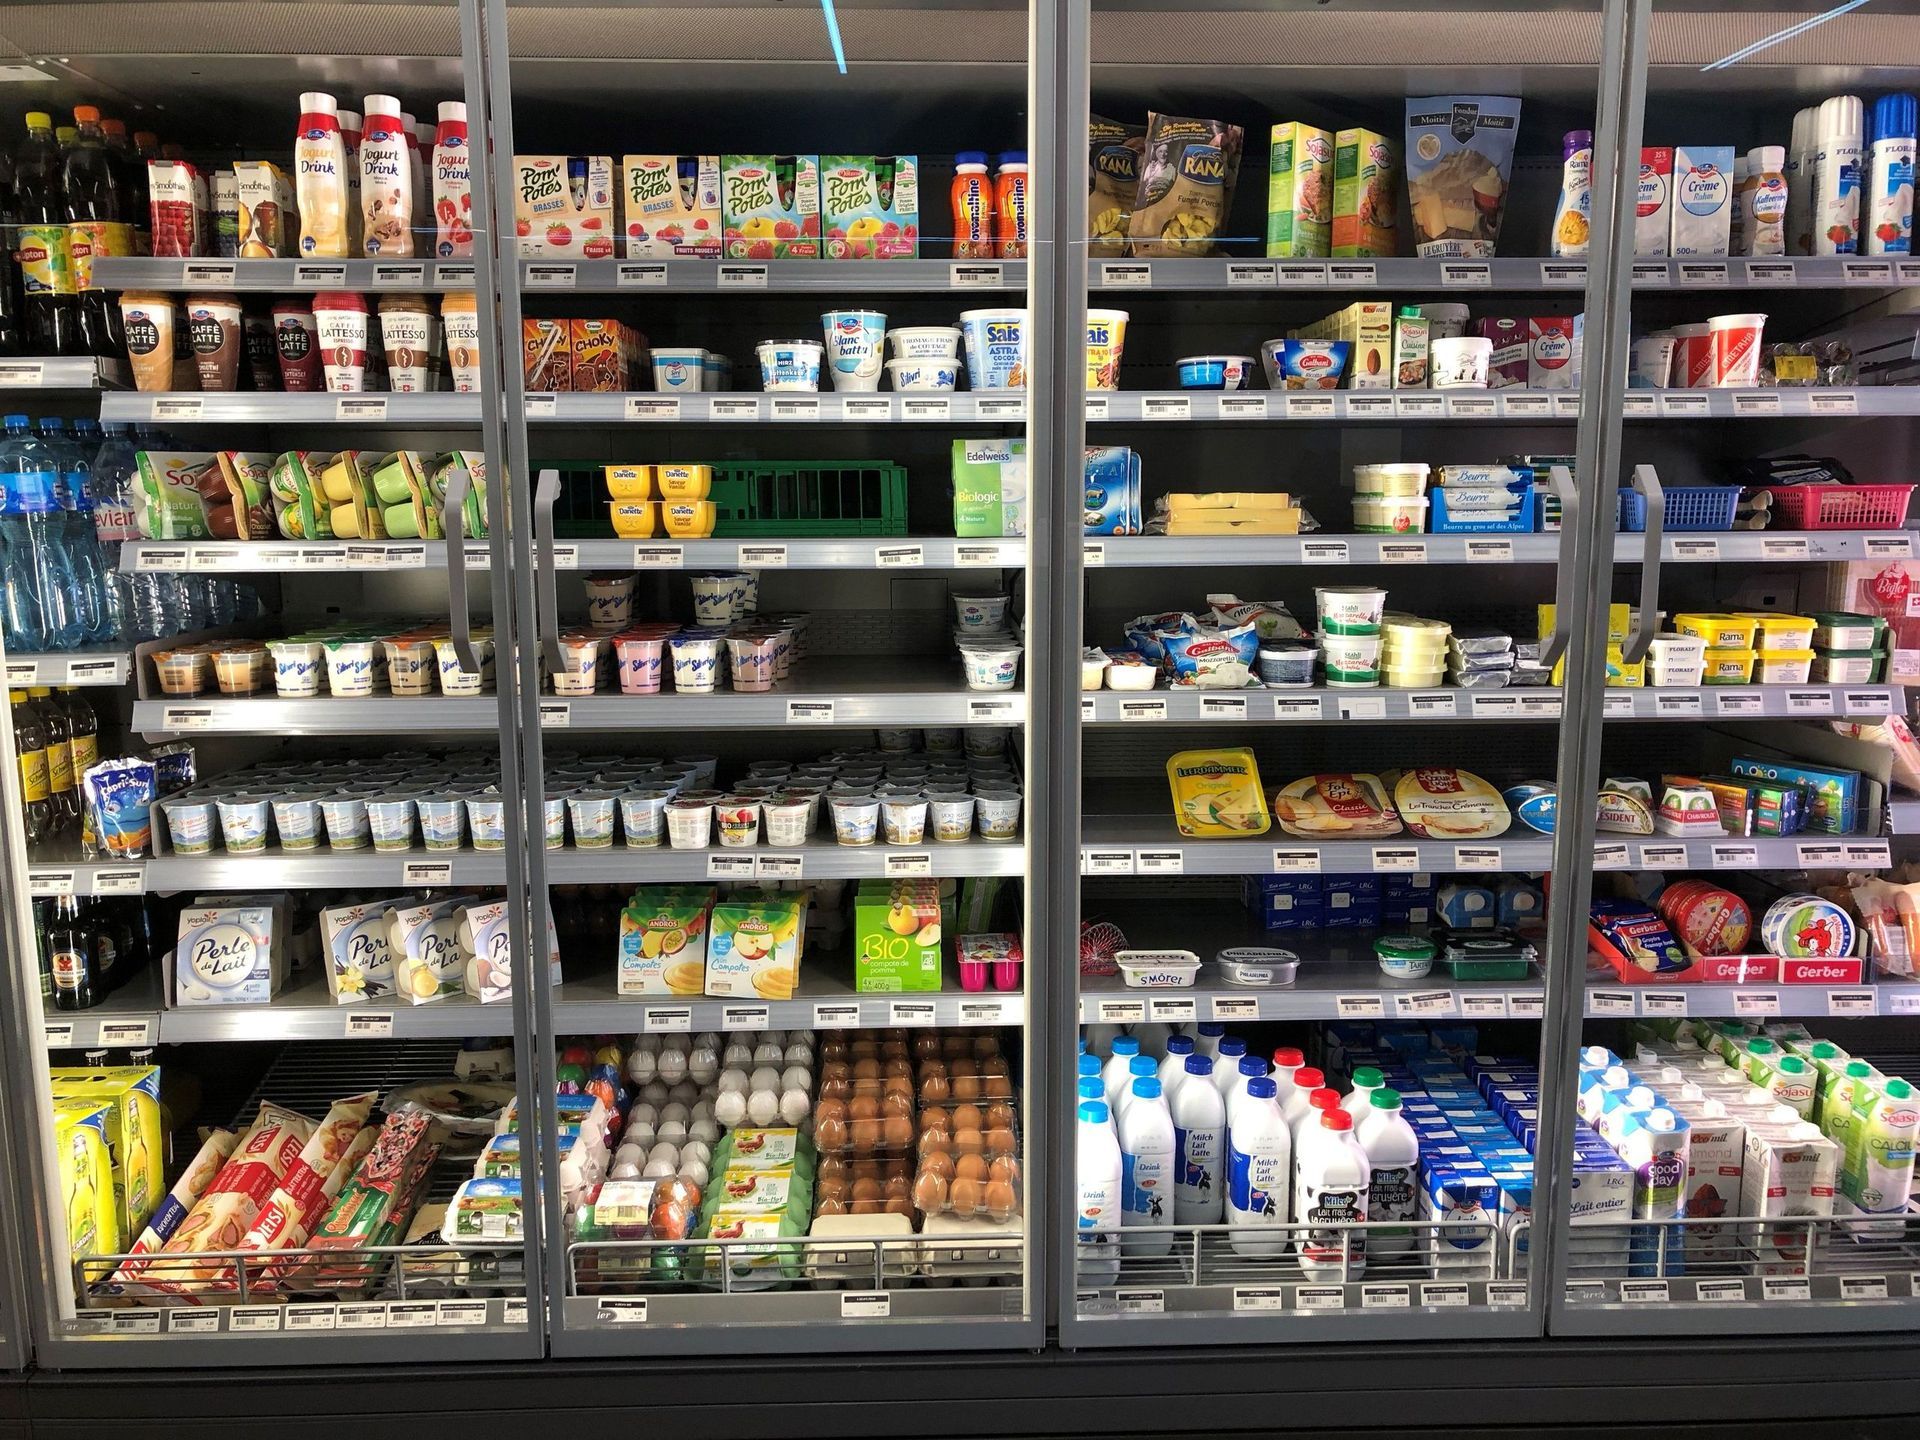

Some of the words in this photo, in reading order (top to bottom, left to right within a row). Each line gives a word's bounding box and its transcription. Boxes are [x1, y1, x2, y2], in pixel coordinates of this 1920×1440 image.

[1454, 106, 1478, 116] Fondue
[1421, 115, 1447, 124] Moitié
[1483, 118, 1505, 127] Moitié
[300, 146, 335, 161] Jogurt
[363, 147, 400, 165] Jogurt
[437, 153, 468, 168] Jogur
[1100, 156, 1134, 177] RANA
[1570, 160, 1589, 169] Rama
[301, 160, 336, 174] Drink
[365, 162, 399, 176] Drink
[1185, 157, 1224, 178] RANA
[439, 168, 470, 180] Drink
[520, 163, 560, 186] Pom'
[631, 164, 670, 186] Pom'
[728, 172, 771, 197] Pom'
[828, 172, 870, 197] Pom'
[1639, 180, 1658, 192] ème
[1688, 180, 1719, 192] Crème
[520, 180, 562, 203] Potes
[631, 180, 672, 203] Potes
[1693, 191, 1713, 201] Rahm
[728, 191, 773, 216] Potes
[828, 191, 872, 216] Potes
[967, 178, 980, 241] ovomaltine
[1013, 178, 1025, 241] ovomaltine
[791, 245, 798, 254] 4
[884, 245, 891, 254] 4
[1423, 245, 1431, 256] LE
[1431, 241, 1462, 255] GRUYÈRE
[1652, 248, 1664, 256] UHT
[1676, 247, 1690, 255] 500
[1691, 247, 1698, 256] ml
[1713, 247, 1725, 255] UHT
[126, 325, 155, 335] CAFFÈ
[191, 324, 220, 335] CAFFÈ
[321, 329, 365, 339] LATTESSO
[384, 330, 426, 340] LATTESSO
[987, 326, 1019, 343] Sais
[1087, 326, 1109, 344] ais
[127, 335, 156, 345] LATTE
[192, 334, 220, 344] LATTE
[278, 331, 307, 342] CAFFÈ
[834, 335, 859, 347] Blanc
[279, 341, 307, 351] LATTE
[840, 345, 868, 356] battu
[1402, 339, 1425, 350] Cuisine
[1540, 340, 1565, 351] Crème
[989, 347, 1018, 355] ASTRA
[1301, 356, 1329, 367] Galbani
[967, 451, 1010, 462] Edelweiss
[166, 470, 199, 489] Soj
[613, 469, 637, 478] Danette
[666, 469, 689, 478] Danette
[1457, 470, 1490, 482] Beurre
[959, 489, 999, 502] Biologic
[1456, 493, 1489, 504] Beurre
[618, 506, 642, 515] Danette
[671, 506, 694, 515] Danette
[1508, 523, 1525, 532] Alpes
[1877, 577, 1905, 598] Bigler
[1683, 625, 1699, 639] Rama
[1719, 632, 1745, 642] Rama
[1186, 644, 1234, 657] Galbani
[1669, 646, 1696, 654] FLORALP
[1198, 655, 1236, 664] Mozzarella
[1719, 662, 1744, 672] Rama
[1176, 765, 1248, 778] LEERDAMMER
[101, 777, 149, 797] Capri-Sun
[1195, 781, 1232, 790] Original
[1325, 781, 1346, 791] Fol
[1329, 790, 1351, 799] Epi
[1333, 802, 1368, 812] Classic
[187, 914, 212, 925] yoplait
[649, 920, 678, 928] ANDROS
[739, 922, 768, 931] ANDROS
[1629, 923, 1661, 934] Gerber
[1704, 908, 1730, 945] Gerber
[196, 936, 250, 963] Perle
[421, 932, 458, 959] Perl
[863, 934, 910, 960] BIO
[201, 963, 212, 971] de
[212, 954, 246, 975] Lait
[358, 957, 369, 967] de
[369, 949, 392, 969] La
[430, 957, 440, 967] de
[440, 948, 461, 969] La
[623, 958, 662, 971] Compotes
[711, 959, 750, 973] Compotes
[870, 961, 900, 969] compote
[870, 967, 896, 975] pomme
[1797, 965, 1847, 979] Gerber
[873, 982, 890, 991] 400g
[250, 1130, 279, 1153] LEISI
[1191, 1133, 1213, 1142] Milch
[281, 1137, 301, 1167] LEISI
[1191, 1149, 1210, 1157] Latte
[1139, 1163, 1161, 1171] Drink
[1256, 1158, 1279, 1167] Milch
[1256, 1167, 1271, 1175] Lait
[1648, 1162, 1680, 1177] good
[1256, 1174, 1276, 1183] Latte
[1606, 1178, 1625, 1186] LRG
[1652, 1174, 1675, 1189] day
[1571, 1202, 1592, 1214] Lait
[1595, 1198, 1625, 1210] entier
[155, 1203, 180, 1234] KUCHENTEIG
[257, 1207, 285, 1240] LEISI
[72, 1228, 96, 1252] CARDINAL
